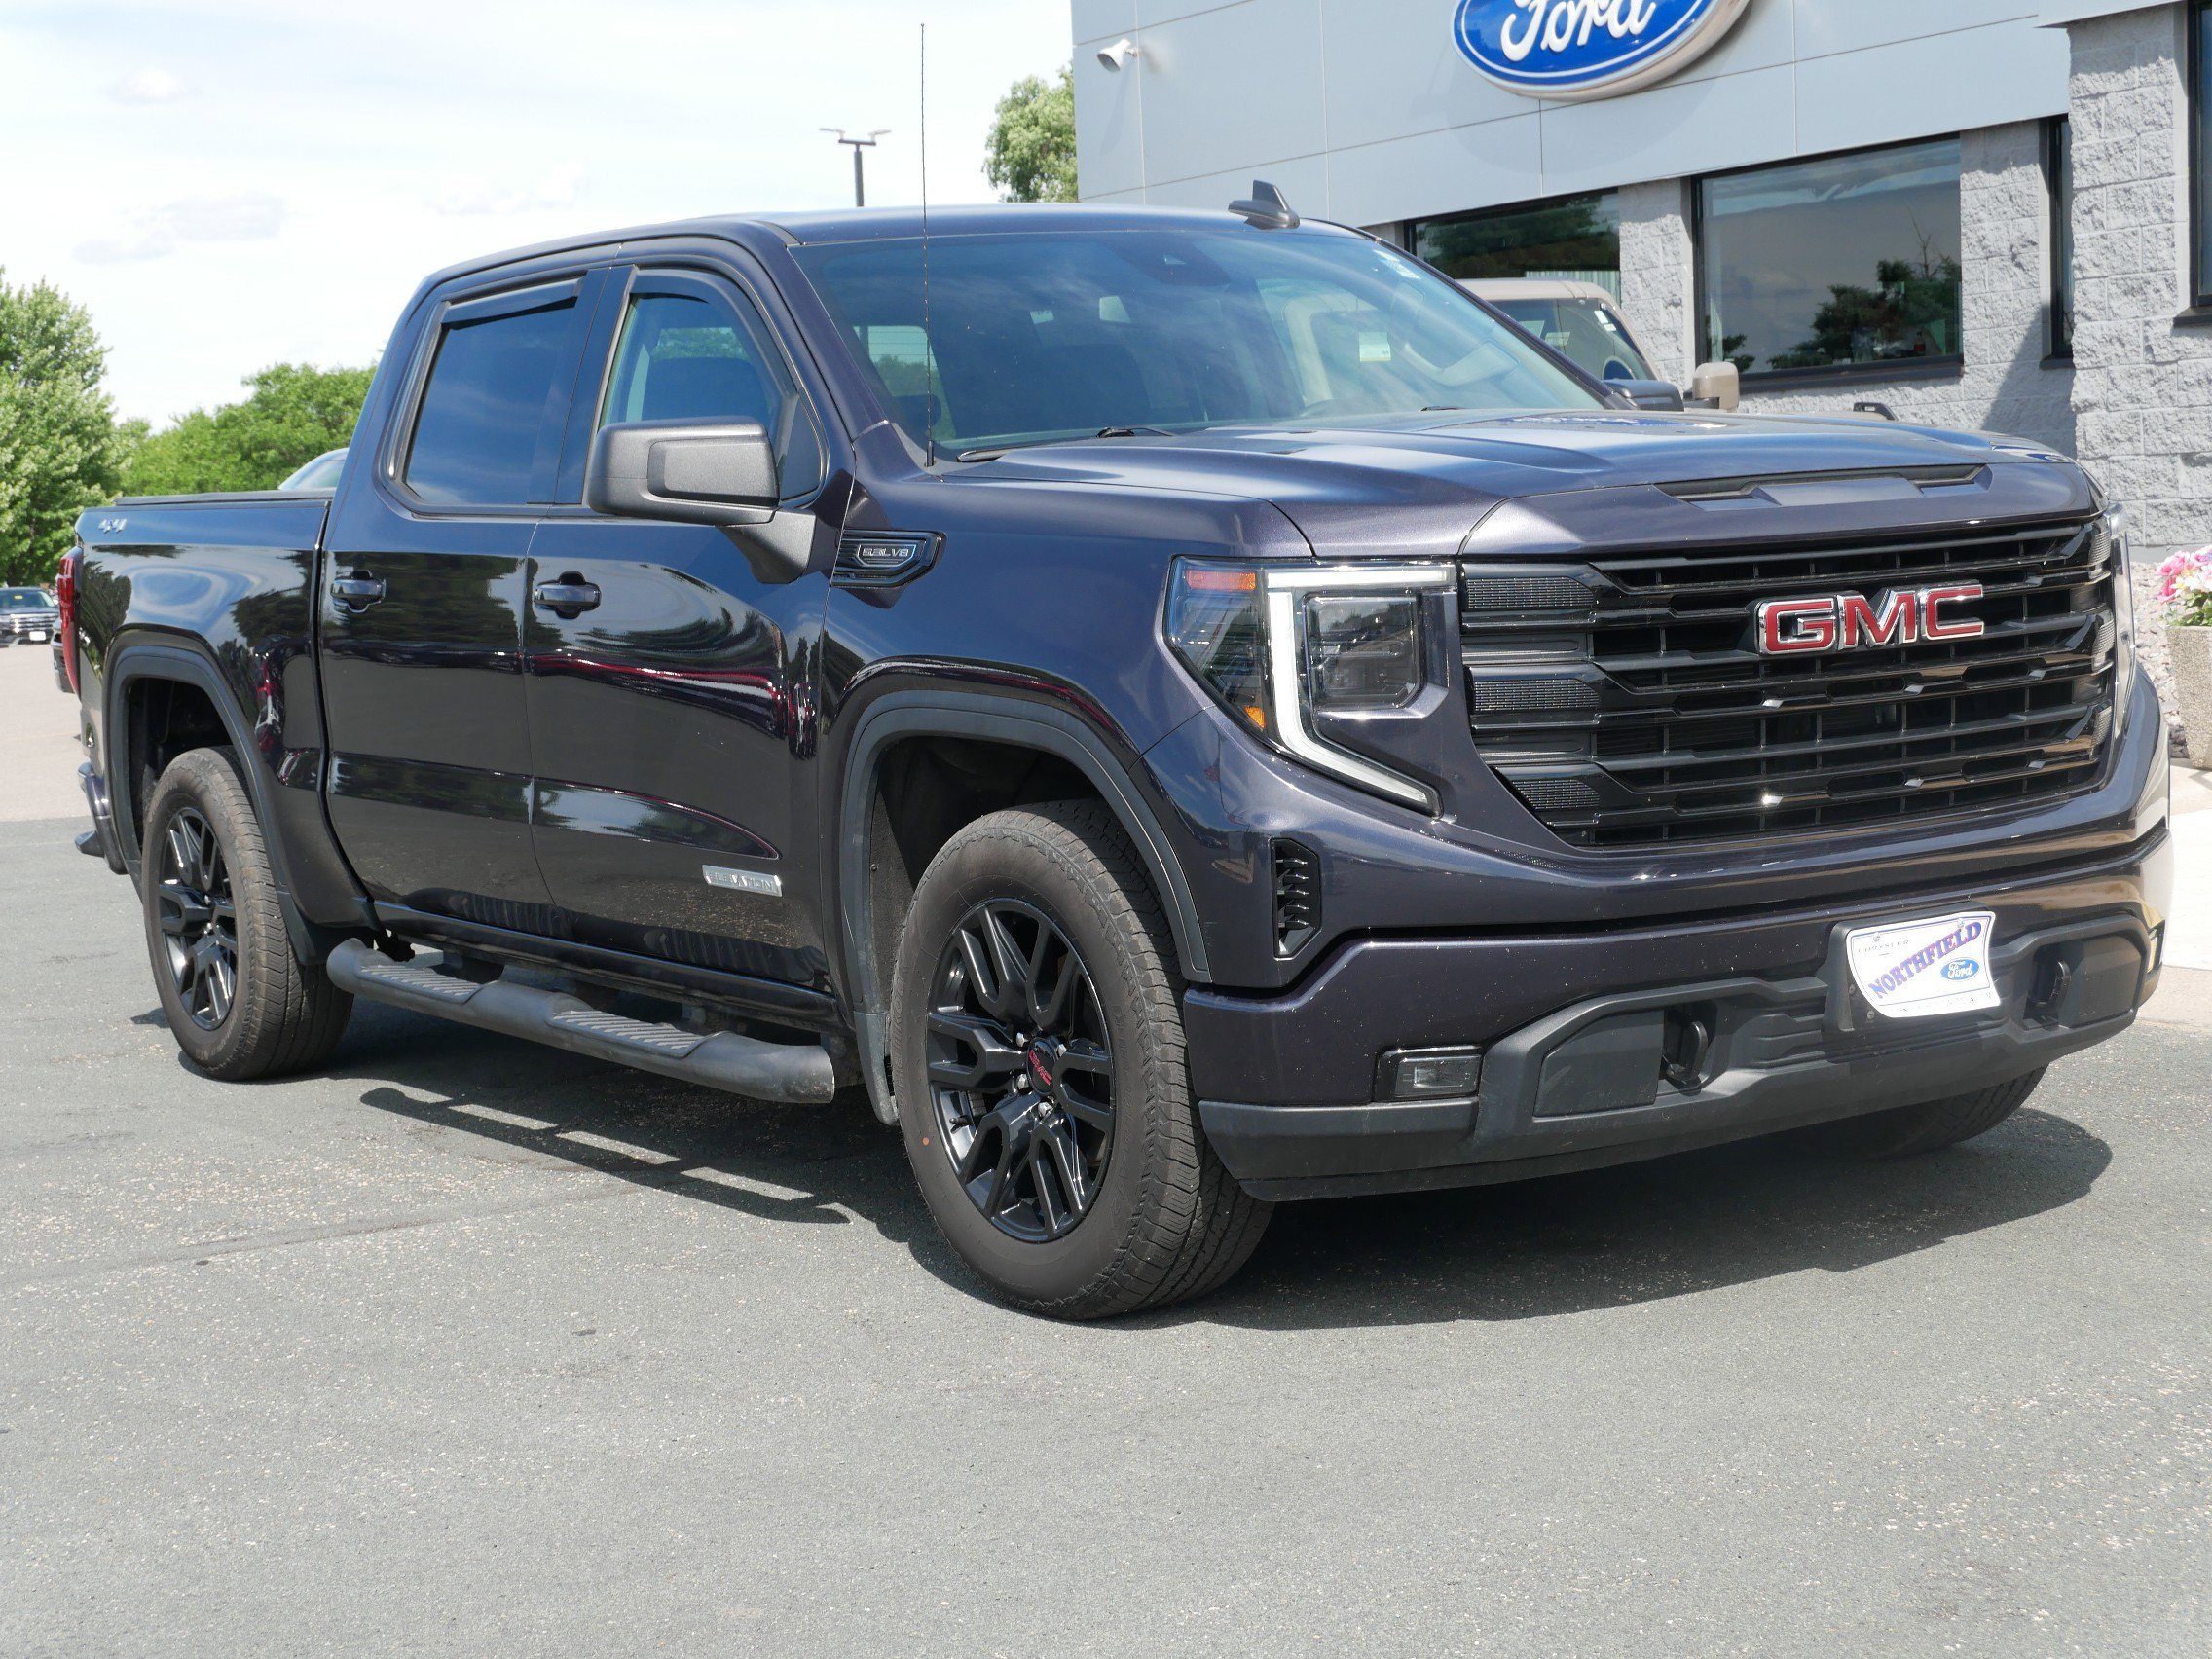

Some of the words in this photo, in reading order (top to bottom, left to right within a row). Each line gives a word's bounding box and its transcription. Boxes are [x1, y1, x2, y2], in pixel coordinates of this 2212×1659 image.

[1758, 584, 1984, 655] GMC
[1868, 921, 1982, 999] NORTHFIELD
[1947, 960, 1974, 977] Ford
[1028, 1049, 1053, 1086] GMC
